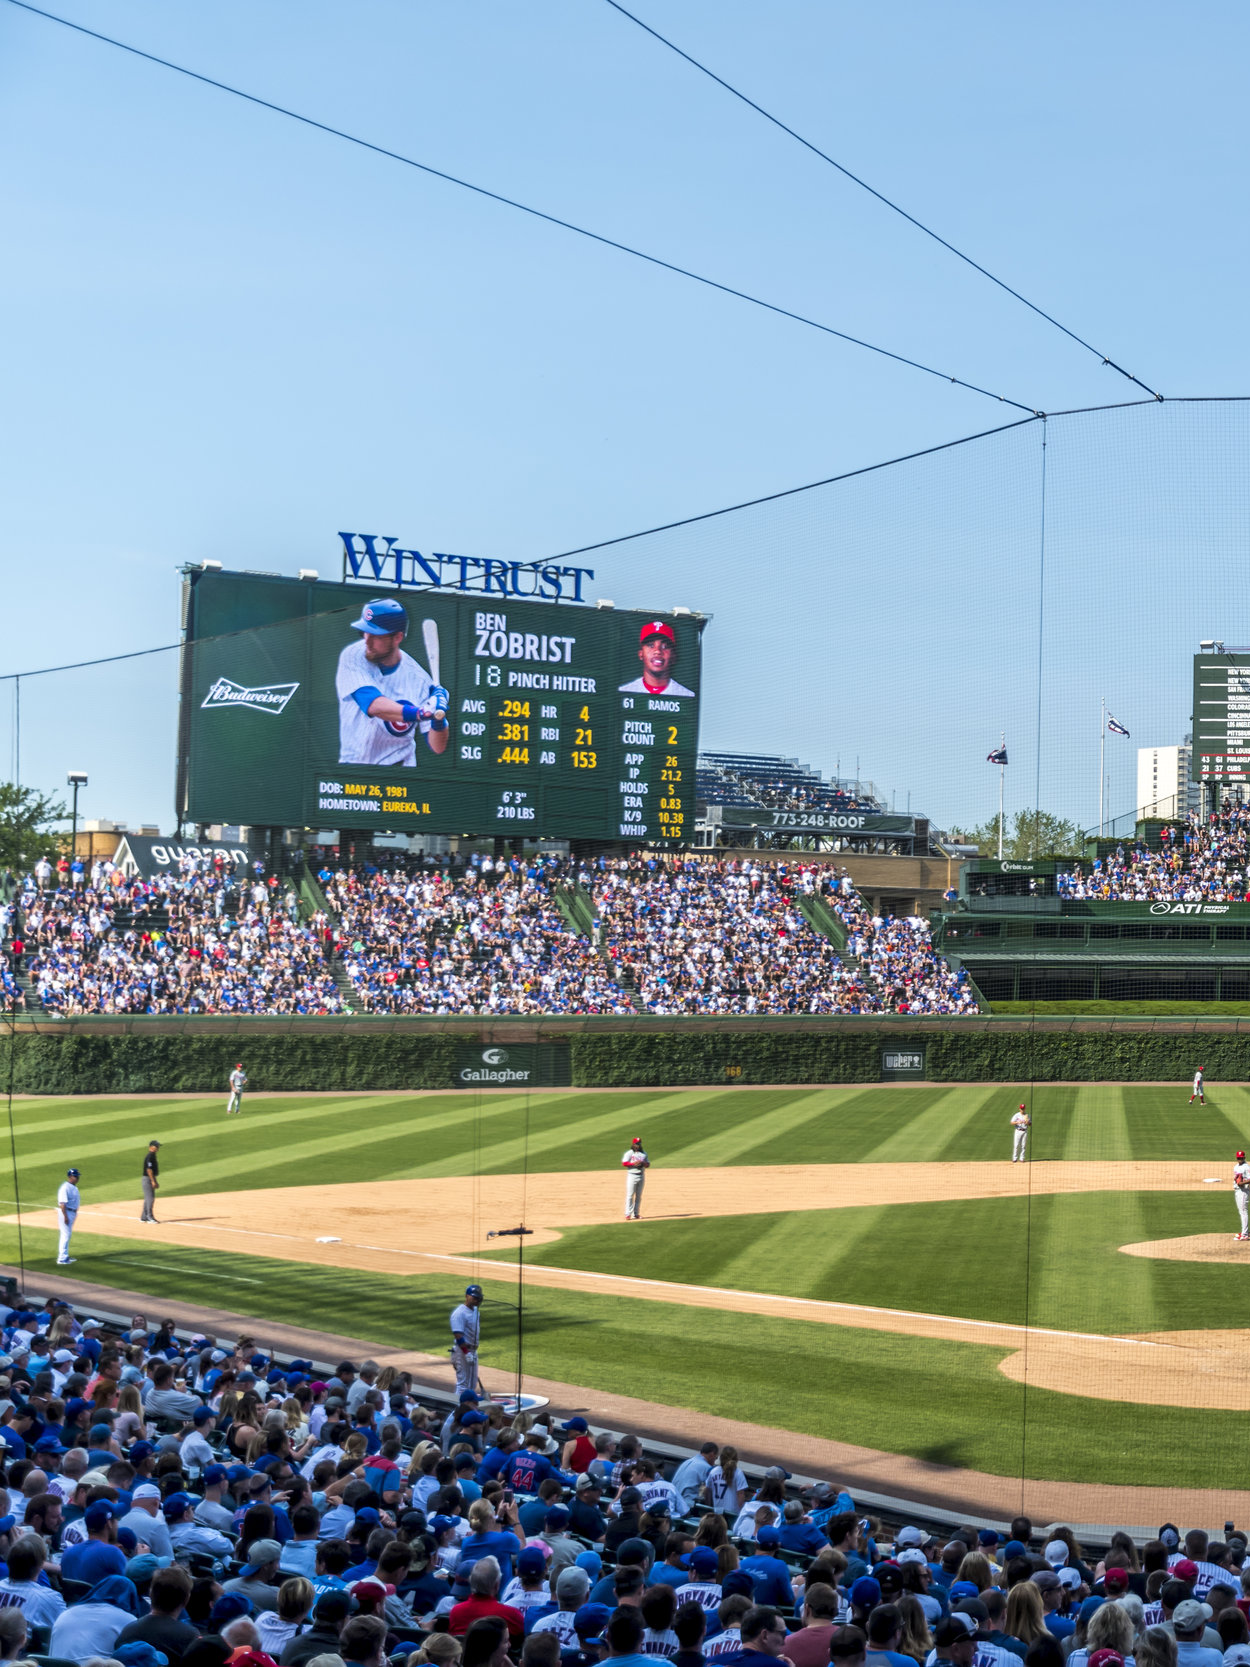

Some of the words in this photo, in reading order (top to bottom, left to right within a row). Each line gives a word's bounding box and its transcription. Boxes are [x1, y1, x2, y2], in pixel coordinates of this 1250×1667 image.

[338, 531, 594, 602] WINTRUST
[475, 612, 506, 631] BEN
[475, 630, 576, 663] ZOBRIST
[475, 664, 501, 687] 18
[508, 671, 549, 689] PINCH
[553, 675, 596, 693] HITTER
[210, 684, 288, 703] Budweiser
[462, 699, 486, 714] AVG
[498, 700, 530, 718] .294
[541, 705, 557, 718] HR
[580, 706, 590, 722] 4
[623, 698, 634, 709] 61
[648, 699, 680, 712] RAMOS
[462, 722, 486, 736] OBP
[498, 723, 529, 741] .381
[541, 727, 560, 741] RBI
[575, 728, 592, 745] 21
[624, 721, 652, 733] PITCH
[623, 733, 655, 745] COUNT
[667, 726, 678, 745] 2
[461, 746, 482, 760] SLG
[497, 747, 529, 764] .444
[540, 751, 556, 764] AB
[571, 751, 597, 768] 153
[625, 753, 644, 765] APP
[666, 756, 678, 767] 26
[629, 767, 640, 779] IP
[661, 769, 682, 781] 21.2
[319, 782, 343, 794] DOB:
[345, 784, 367, 795] MAY
[368, 785, 383, 798] 26,
[386, 786, 407, 797] 1981
[620, 781, 648, 794] HOLDS
[668, 784, 675, 795] 5
[502, 791, 513, 803] 6'
[514, 792, 527, 804] 3"
[624, 796, 643, 808] ERA
[660, 798, 681, 810] 0.83
[319, 798, 380, 812] HOMETOWN:
[382, 801, 420, 815] EUREKA,
[422, 803, 431, 814] IL
[497, 806, 515, 818] 210
[517, 807, 535, 819] LBS
[624, 810, 642, 822] K/9
[658, 812, 684, 824] 10.38
[772, 813, 865, 828] 773-248-ROOF
[620, 824, 647, 836] WHIP
[661, 826, 681, 837] 1.15
[1170, 903, 1202, 914] ATI
[886, 1053, 913, 1068] weber
[461, 1068, 530, 1083] Gallagher
[512, 1468, 535, 1491] 44
[714, 1483, 728, 1500] 17
